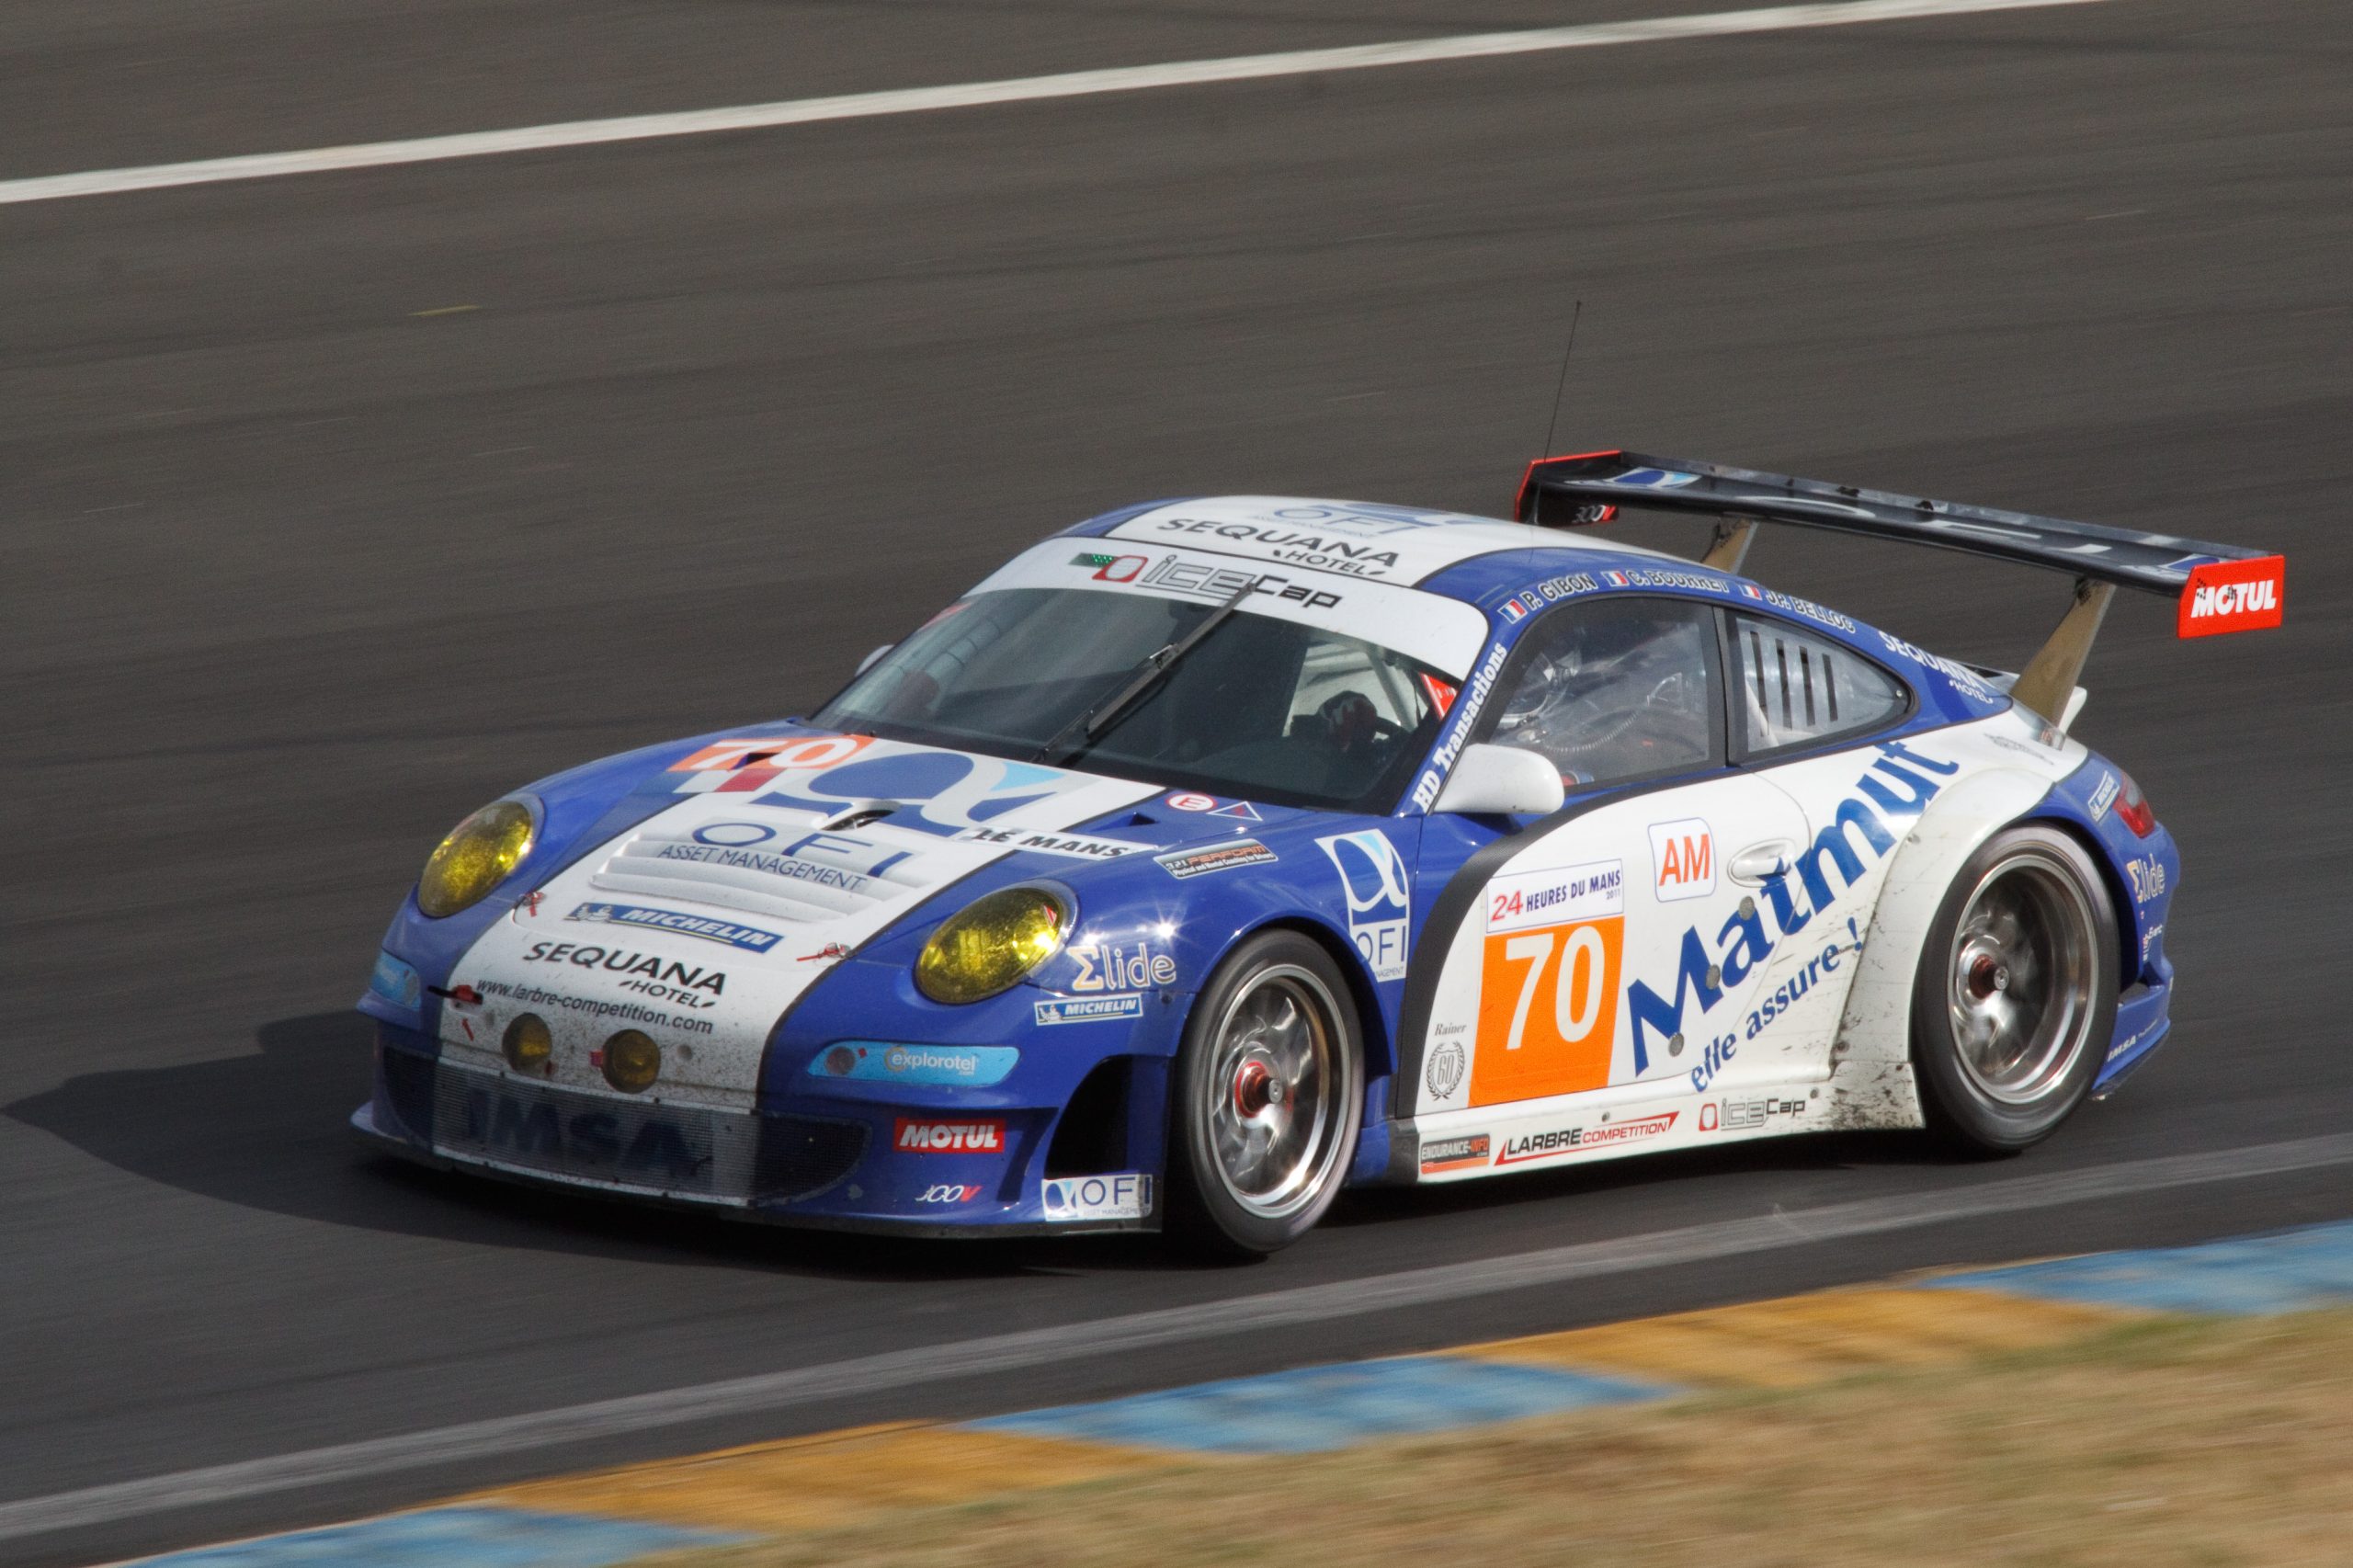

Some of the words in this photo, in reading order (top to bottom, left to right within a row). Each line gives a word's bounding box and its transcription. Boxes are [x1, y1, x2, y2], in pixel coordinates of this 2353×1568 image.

[1156, 517, 1400, 568] SEQUANA
[1286, 551, 1366, 575] HOTEL
[1625, 570, 1649, 587] C.
[1519, 590, 1544, 612] P.
[1538, 573, 1599, 602] GIBON
[2190, 579, 2277, 619] MOTUL
[1791, 596, 1857, 635] BELLOC
[1412, 769, 1441, 813] HD
[1432, 642, 1508, 772] Transactions
[690, 737, 858, 769] 70
[691, 822, 914, 879] OFI
[971, 829, 1017, 843] LE
[1017, 835, 1130, 858] MANS
[1657, 833, 1711, 887] AM
[656, 844, 714, 864] ASSET
[722, 848, 869, 892] MANAGEMENT
[1491, 889, 1524, 923] 24
[1526, 884, 1567, 913] HEURES
[1570, 881, 1586, 900] DU
[1589, 869, 1621, 894] MANS
[1606, 888, 1621, 901] 2011
[1627, 740, 1960, 1079] Matmut
[620, 908, 776, 948] MICHELIN
[523, 941, 727, 995] SEQUANA
[475, 977, 713, 1035] www.larbre-competition.com
[630, 979, 701, 1008] HOTEL
[1063, 998, 1138, 1016] MICHELIN
[1505, 925, 1606, 1051] 70
[1434, 1022, 1467, 1037] Rainer
[1690, 1029, 1737, 1093] elle
[1745, 942, 1840, 1040] assure
[892, 1051, 978, 1071] explorotel
[899, 1124, 999, 1149] MOTUL
[1506, 1127, 1583, 1156] LARBRE
[1583, 1121, 1667, 1144] COMPETITION
[1081, 1176, 1151, 1206] OFI
